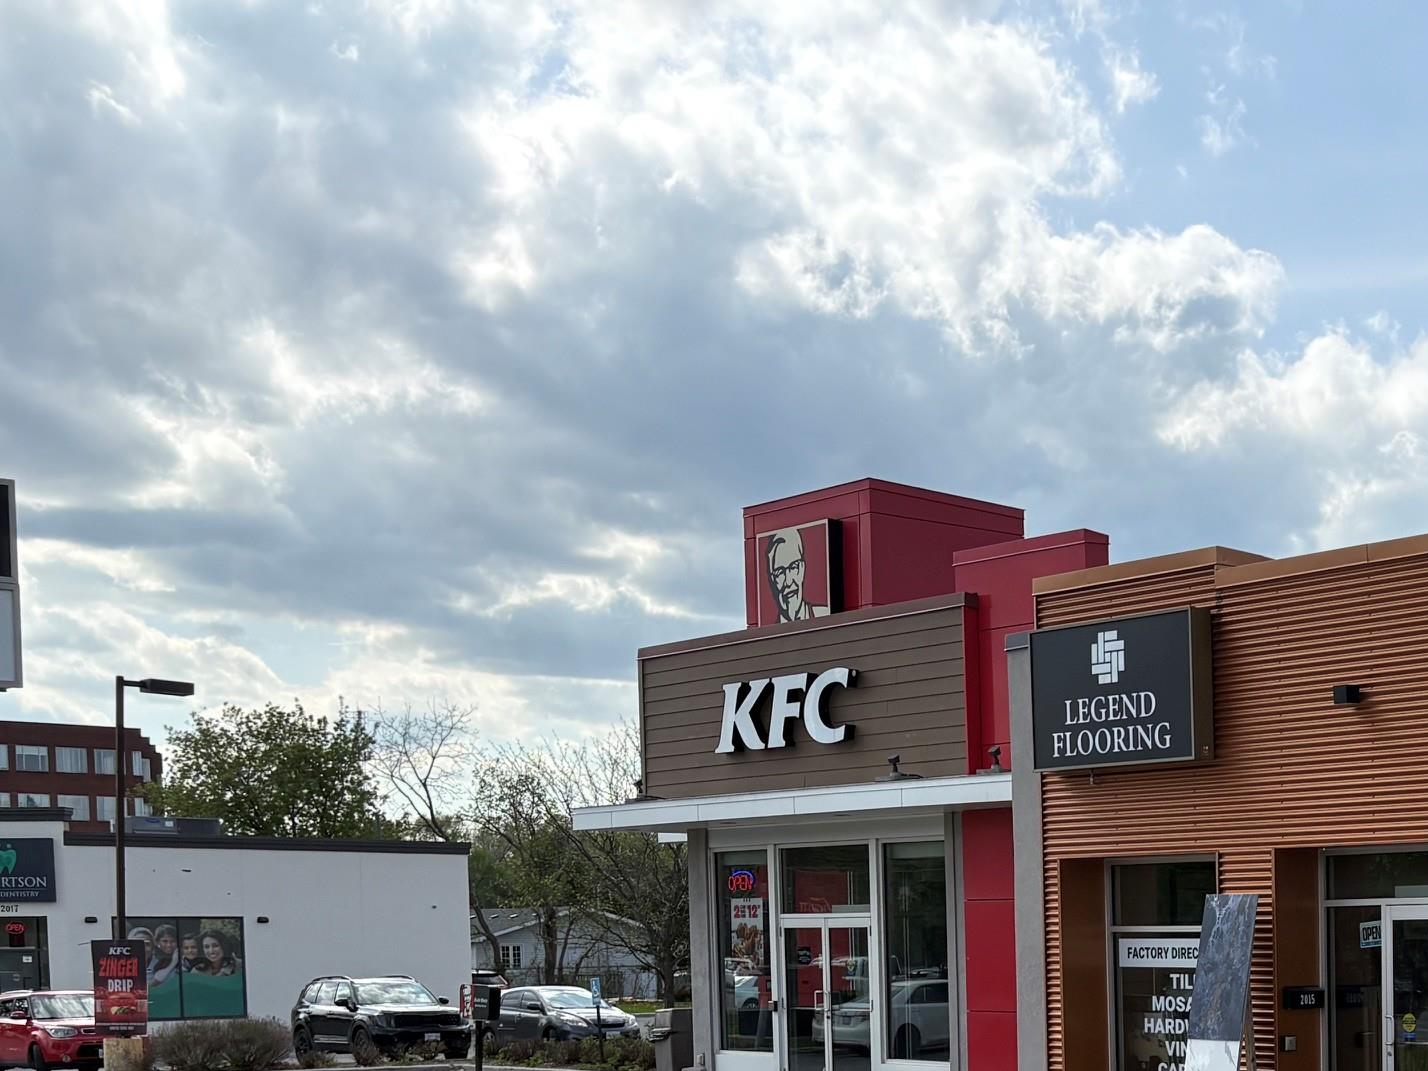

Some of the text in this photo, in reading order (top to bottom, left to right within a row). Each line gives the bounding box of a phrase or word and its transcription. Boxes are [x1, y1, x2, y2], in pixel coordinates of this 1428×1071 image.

[714, 667, 852, 754] KFC
[1064, 691, 1156, 725] LEGEND
[1052, 722, 1172, 758] FLOORING
[728, 875, 753, 892] OPEN
[0, 890, 40, 898] DENTISTRY
[0, 904, 19, 913] 2017
[6, 923, 25, 932] OPEN
[1362, 926, 1382, 941] OPEN
[108, 946, 131, 955] KFC
[1127, 946, 1199, 960] FACTORY DIREC
[98, 957, 138, 977] ZINGER
[107, 979, 134, 993] DRIP
[1169, 973, 1196, 990] TIL
[1152, 996, 1193, 1012] MOSA
[1300, 993, 1316, 1005] 2015
[1144, 1018, 1189, 1035] HARD
[1165, 1041, 1188, 1057] VIN
